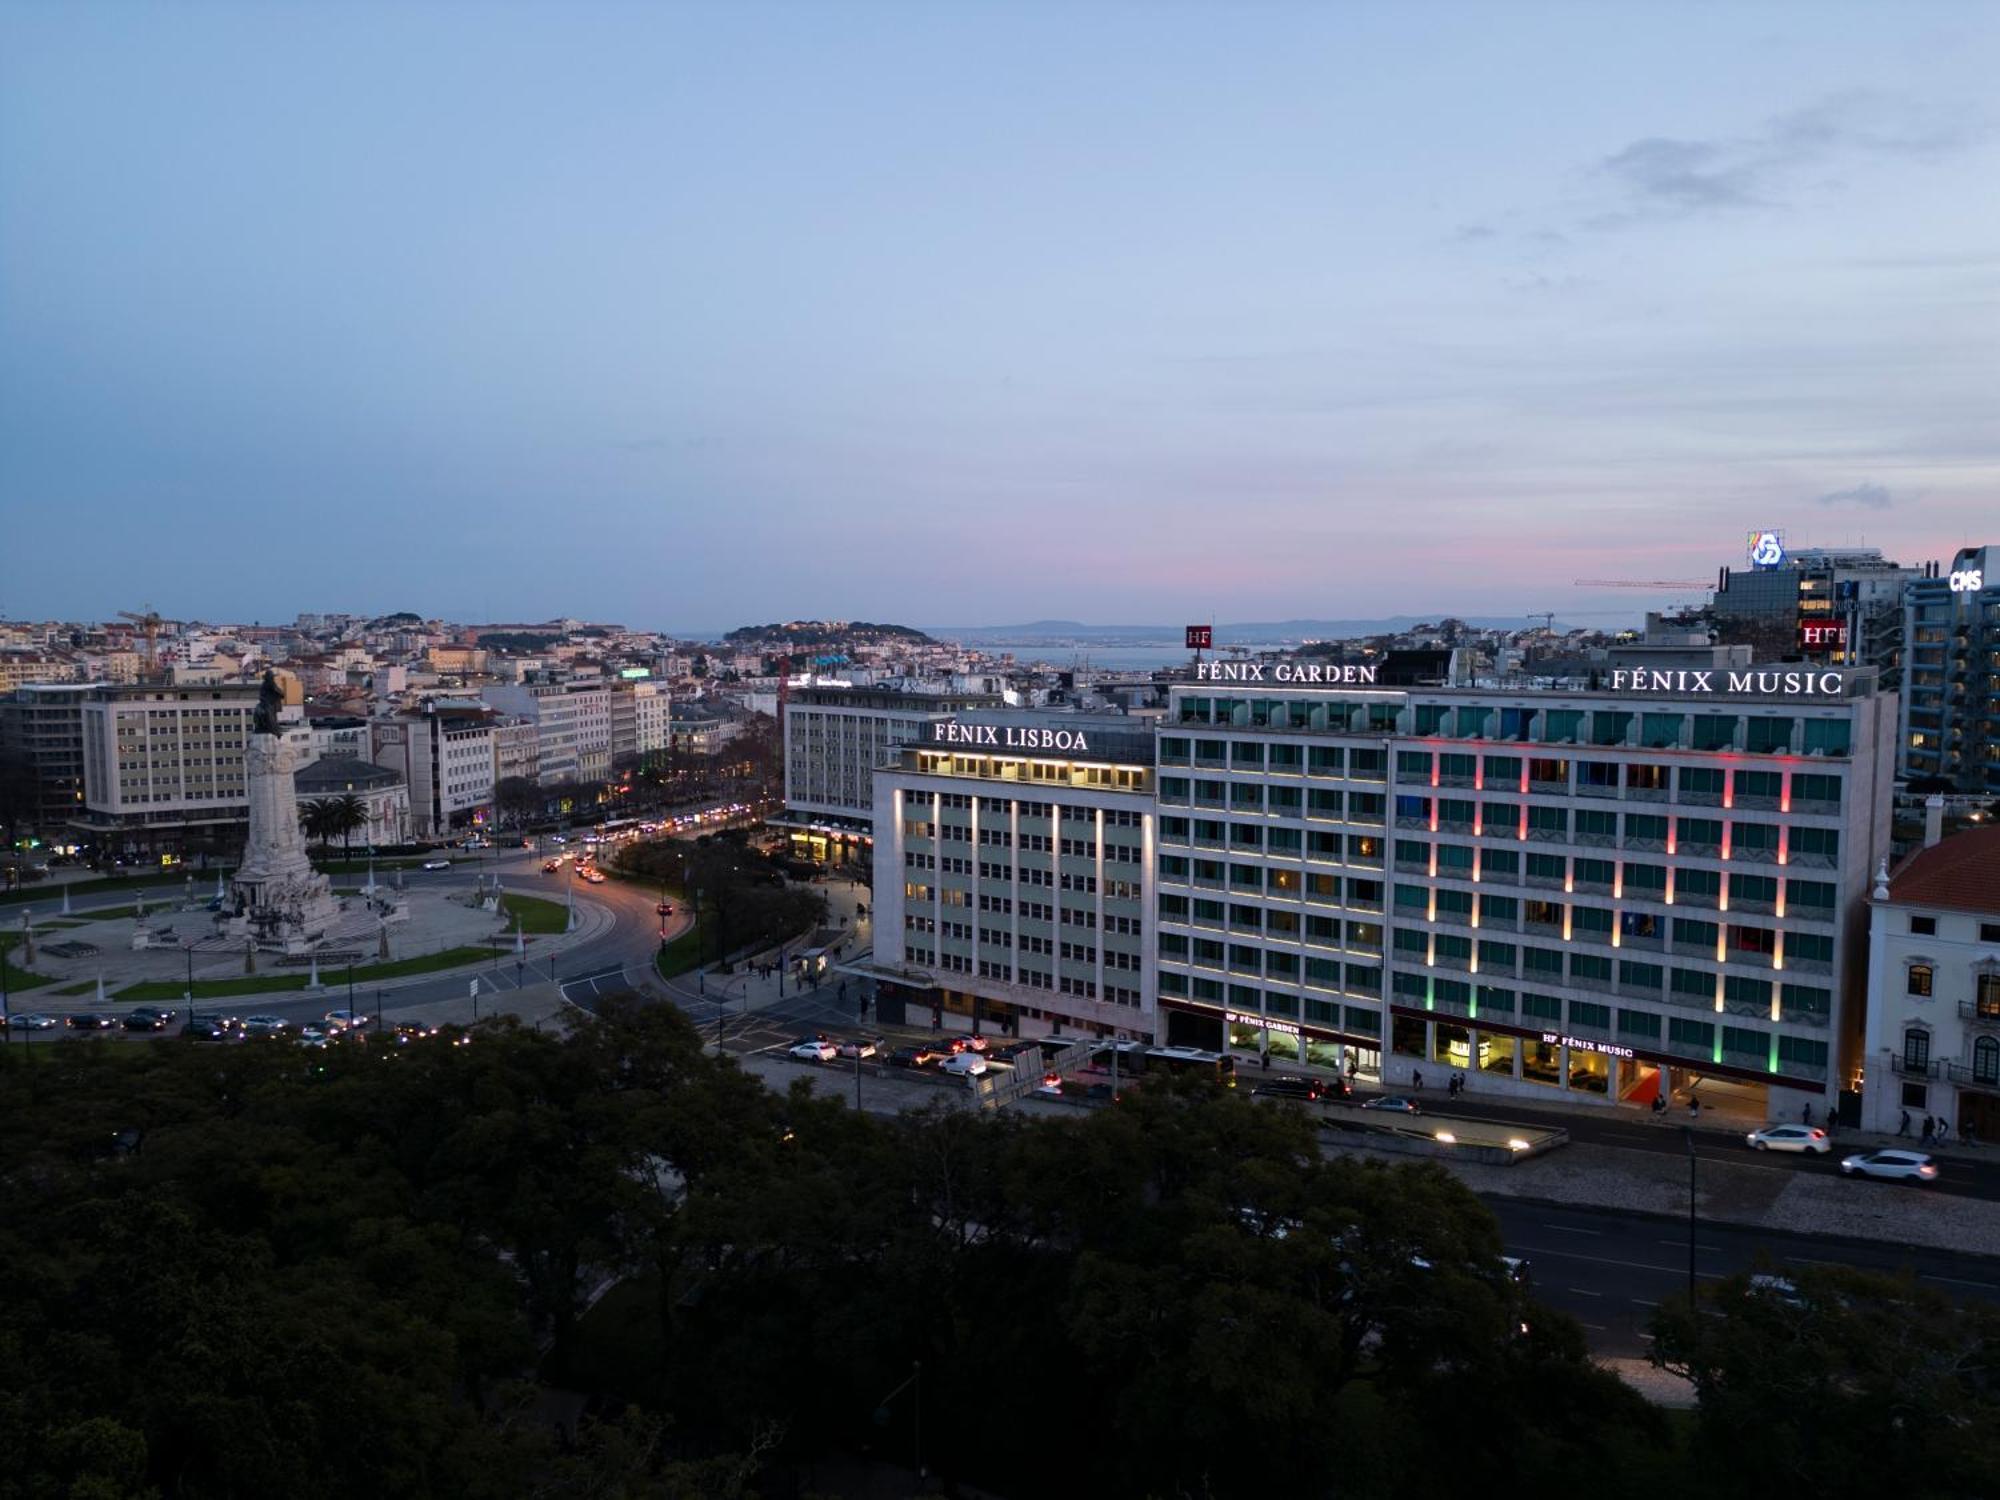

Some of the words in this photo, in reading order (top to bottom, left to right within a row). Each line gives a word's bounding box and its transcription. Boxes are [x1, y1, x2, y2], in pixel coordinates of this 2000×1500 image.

[1949, 569, 1982, 592] CMS
[1188, 631, 1210, 644] HF
[1197, 660, 1265, 681] FÉNIX
[1275, 664, 1377, 683] GARDEN
[1611, 666, 1713, 692] FÉNIX
[1728, 671, 1843, 694] MUSIC
[934, 720, 998, 744] FÉNIX
[1006, 727, 1088, 750] LISBOA
[1240, 1016, 1264, 1027] FÉNIX
[1265, 1022, 1300, 1034] GARDEN
[1543, 1034, 1557, 1043] HF
[1562, 1037, 1595, 1050] FÉNIX
[1598, 1044, 1633, 1057] MUSIC
